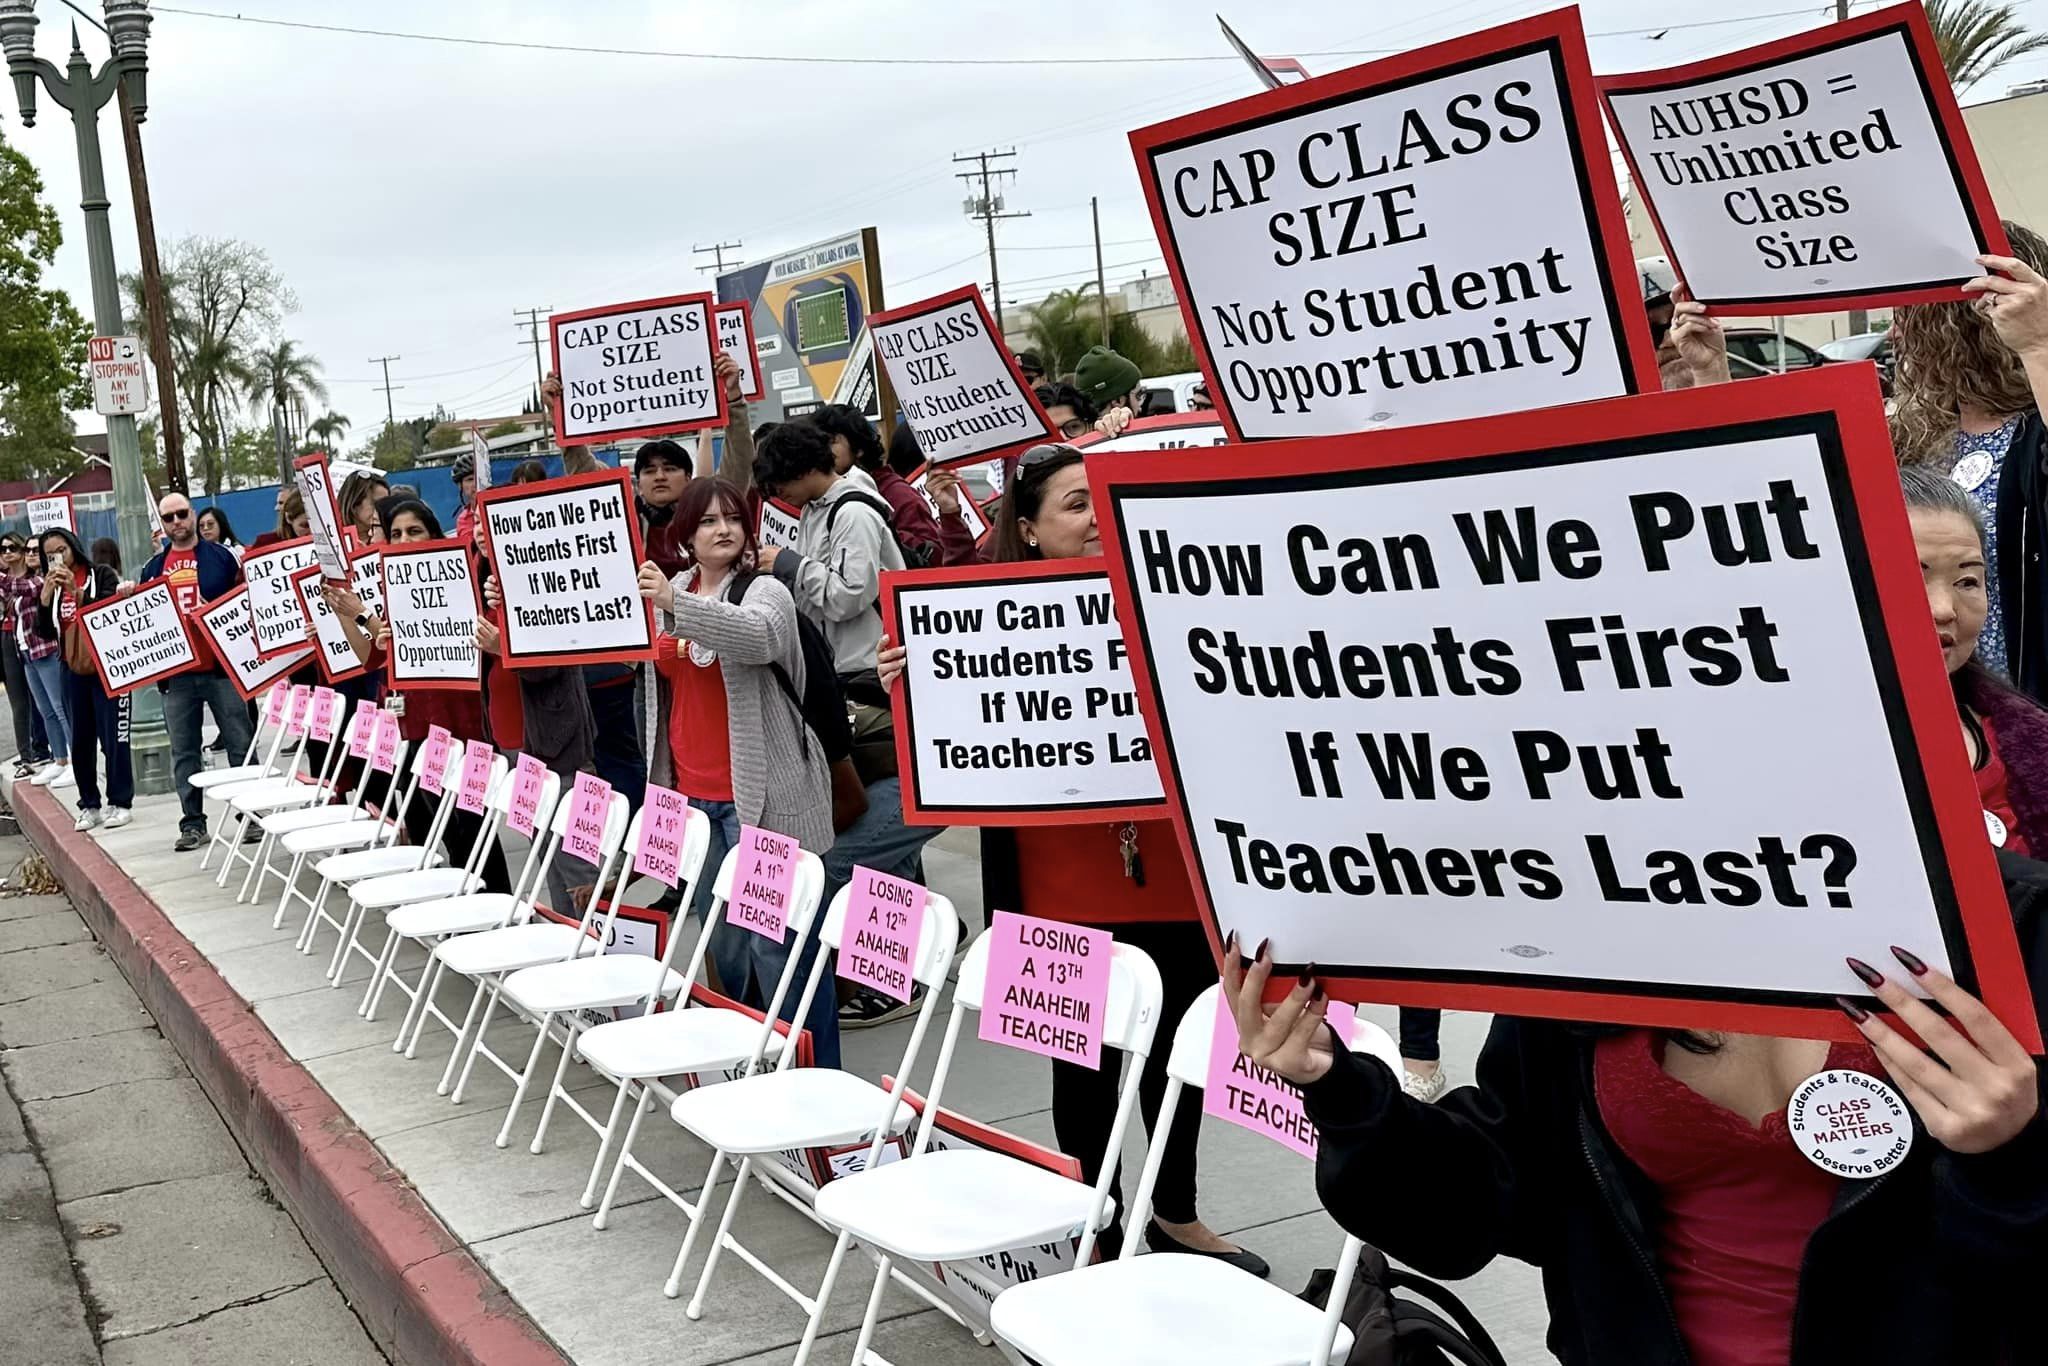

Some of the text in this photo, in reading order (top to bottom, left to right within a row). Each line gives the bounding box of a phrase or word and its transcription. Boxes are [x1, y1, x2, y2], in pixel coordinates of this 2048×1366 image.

[1650, 74, 1857, 141] AUHSD =
[1174, 80, 1542, 219] CAP CLASS
[1650, 108, 1902, 186] Unlimited
[1724, 185, 1850, 226] Class
[1268, 183, 1428, 267] SIZE
[1756, 231, 1858, 270] Size
[1212, 246, 1572, 348] Not Student
[1641, 272, 1666, 299] A
[563, 311, 701, 349] CAP CLASS
[720, 315, 742, 331] Put
[878, 311, 979, 360] CAP CLASS
[91, 340, 111, 359] NO
[602, 341, 662, 368] SIZE
[720, 333, 738, 348] rst
[95, 361, 140, 379] STOPPING
[906, 352, 956, 385] SIZE
[1229, 316, 1592, 416] Opportunity
[111, 380, 128, 392] ANY
[570, 365, 705, 399] Not Student
[111, 393, 130, 405] TIME
[570, 387, 710, 423] Opportunity
[901, 377, 1011, 420] Not Student
[491, 495, 622, 537] How Can We Put
[763, 508, 786, 534] How
[504, 530, 618, 566] Students First
[1139, 479, 1820, 597] How Can We Put
[247, 553, 320, 583] CAP CLA
[387, 557, 466, 585] CAP CLASS
[527, 566, 601, 595] If We Put
[271, 579, 291, 595] SI
[304, 583, 321, 600] Ho
[410, 586, 449, 610] SIZE
[90, 608, 121, 630] CAP
[125, 589, 169, 617] CLASS
[120, 613, 154, 637] SIZE
[210, 607, 240, 630] How
[255, 606, 278, 623] Not
[514, 595, 633, 628] Teachers Last?
[909, 605, 983, 635] How
[996, 599, 1065, 631] Can
[395, 616, 475, 640] Not Student
[105, 625, 180, 663] Not Student
[109, 641, 186, 678] Opportunity
[398, 643, 478, 668] Opportunity
[1188, 607, 1790, 698] Students First
[932, 643, 1093, 679] Students
[118, 693, 130, 742] STON
[980, 691, 1005, 723] If
[1015, 690, 1072, 722] We
[933, 738, 1094, 769] Teachers
[1285, 728, 1683, 802] If We Put
[584, 780, 606, 800] LOSING
[656, 793, 682, 814] LOSING
[584, 800, 591, 814] A
[656, 814, 663, 829] A
[571, 835, 600, 857] TEACHER
[647, 834, 679, 857] ANAHEIM
[754, 834, 790, 860] LOSING
[644, 853, 676, 878] TEACHER
[754, 860, 762, 876] A
[1214, 820, 1858, 910] Teachers Last?
[742, 880, 784, 909] ANAHEIM
[868, 878, 913, 908] LOSING
[738, 902, 781, 934] TEACHER
[868, 906, 908, 932] A 12TH
[855, 930, 909, 965] ANAHEIM
[1019, 924, 1090, 957] LOSING
[850, 954, 906, 993] TEACHER
[1021, 957, 1083, 985] A 13TH
[1004, 985, 1090, 1024] ANAHEIM
[999, 1013, 1088, 1056] TEACHER
[1793, 1072, 1902, 1131] Students & Teachers
[1816, 1098, 1872, 1116] CLASS
[1813, 1122, 1894, 1145] MATTERS
[1828, 1112, 1869, 1128] SIZE
[1812, 1136, 1908, 1174] Deserve Better
